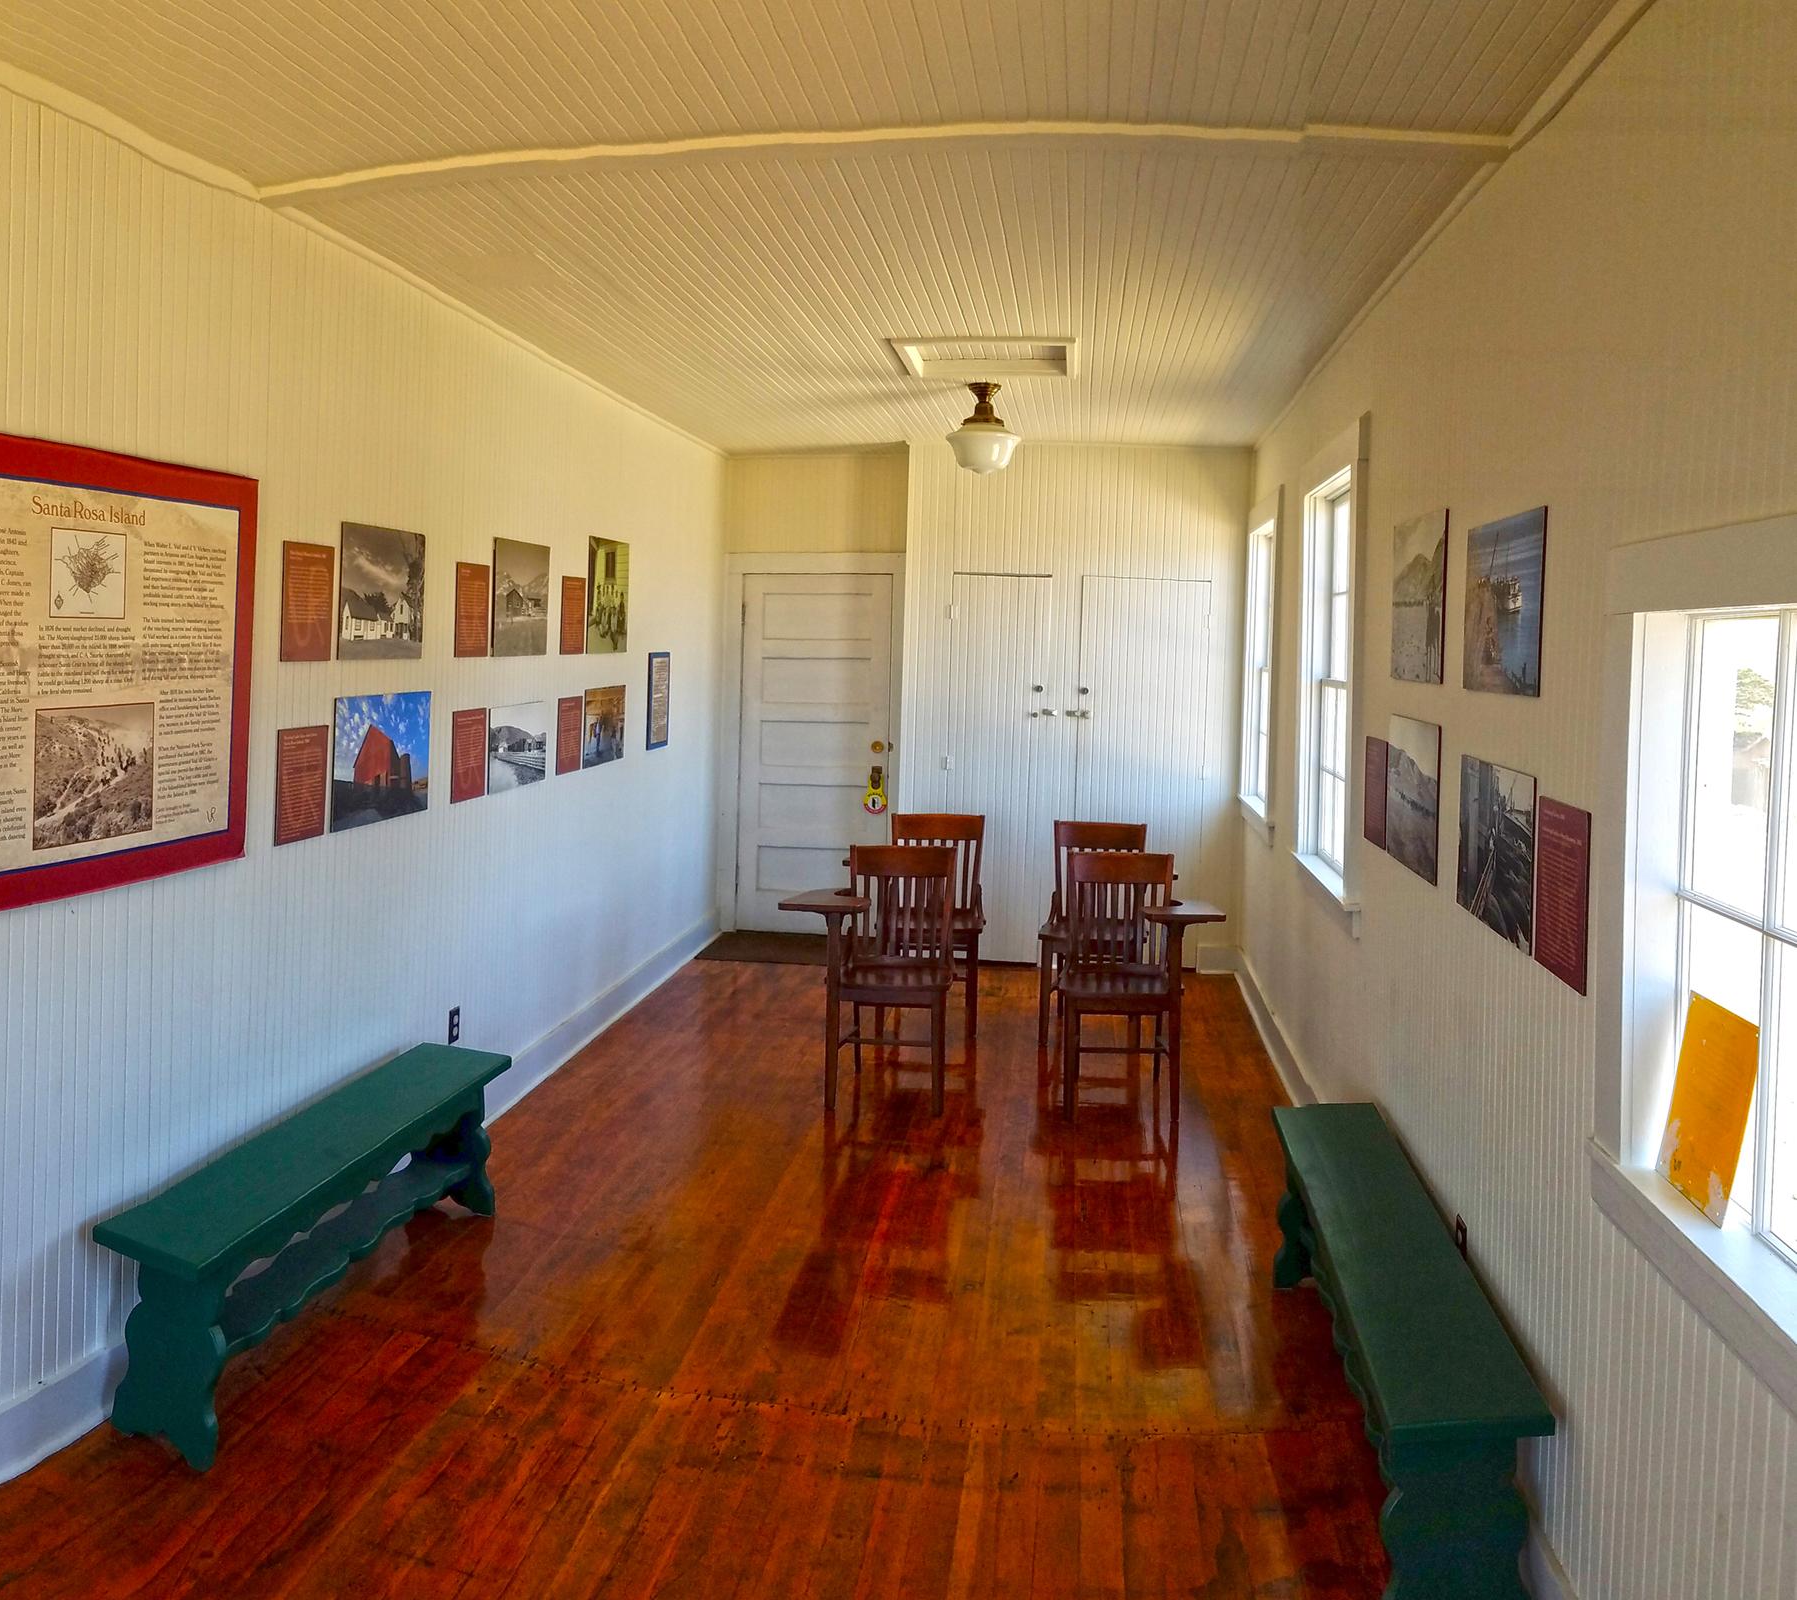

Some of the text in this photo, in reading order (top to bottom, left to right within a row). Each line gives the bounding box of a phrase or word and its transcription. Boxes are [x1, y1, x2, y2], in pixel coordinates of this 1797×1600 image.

[32, 497, 146, 525] Santa Rosa Island
